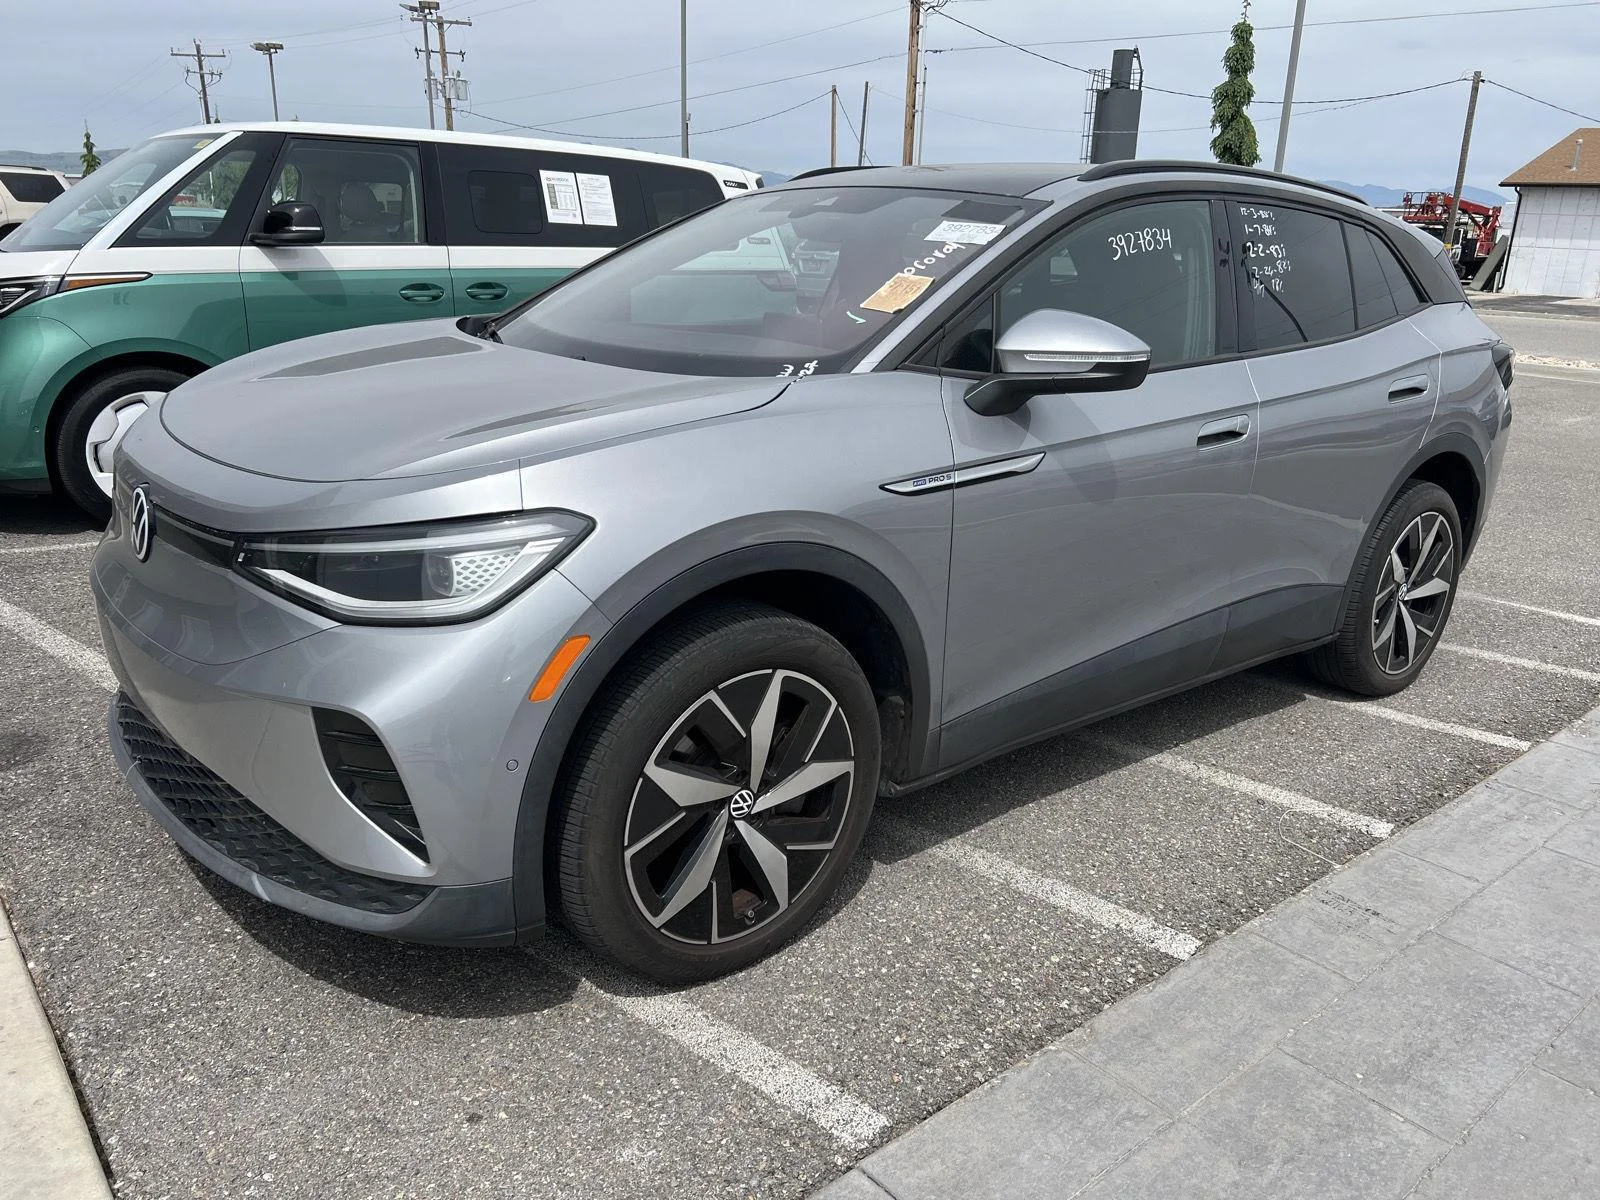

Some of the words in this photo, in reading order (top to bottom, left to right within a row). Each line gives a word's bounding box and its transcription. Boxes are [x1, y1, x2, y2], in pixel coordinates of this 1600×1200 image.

[1107, 227, 1172, 261] 3927834
[928, 475, 946, 484] PRO
[945, 473, 952, 481] S
